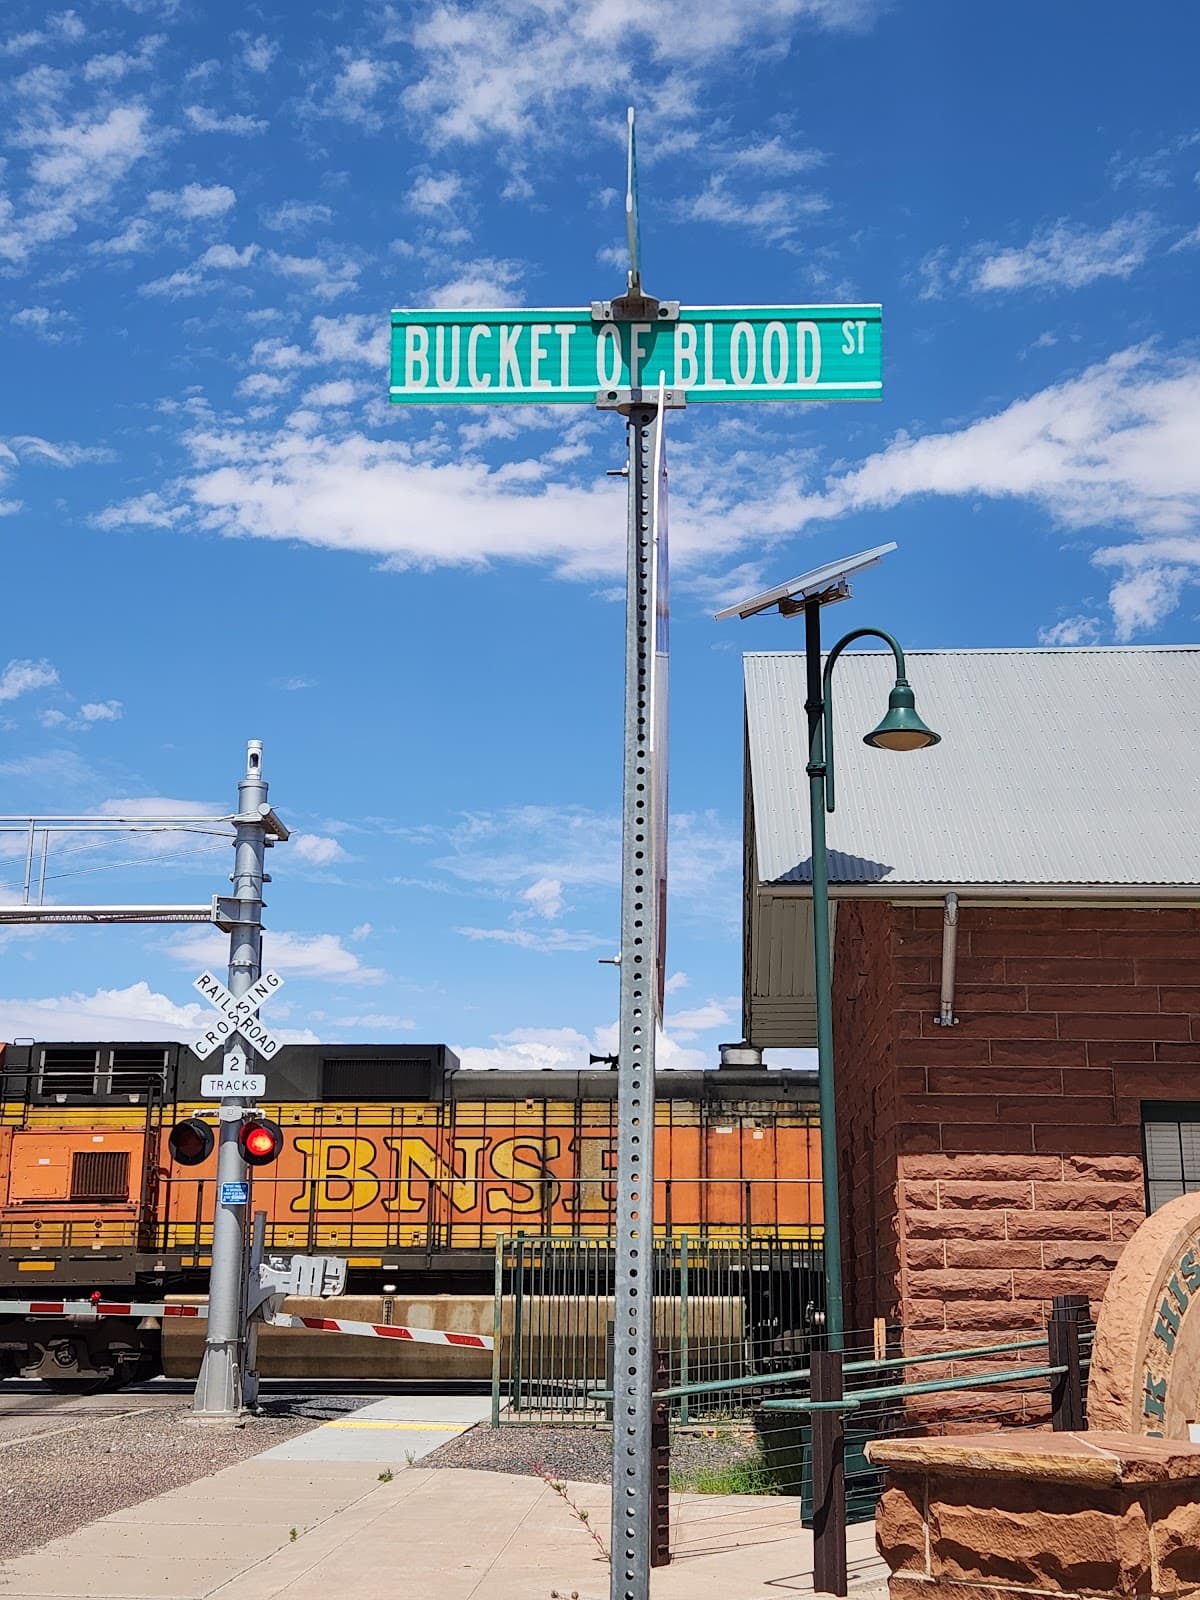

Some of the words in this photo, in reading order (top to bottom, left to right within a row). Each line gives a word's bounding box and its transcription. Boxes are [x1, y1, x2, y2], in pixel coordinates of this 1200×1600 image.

[404, 324, 577, 392] BUCKET
[596, 323, 652, 389] OF
[673, 321, 822, 387] BLOOD
[842, 320, 867, 355] ST
[195, 974, 279, 1054] CROSSING
[230, 1056, 239, 1071] 2
[210, 1080, 257, 1091] TRACKS
